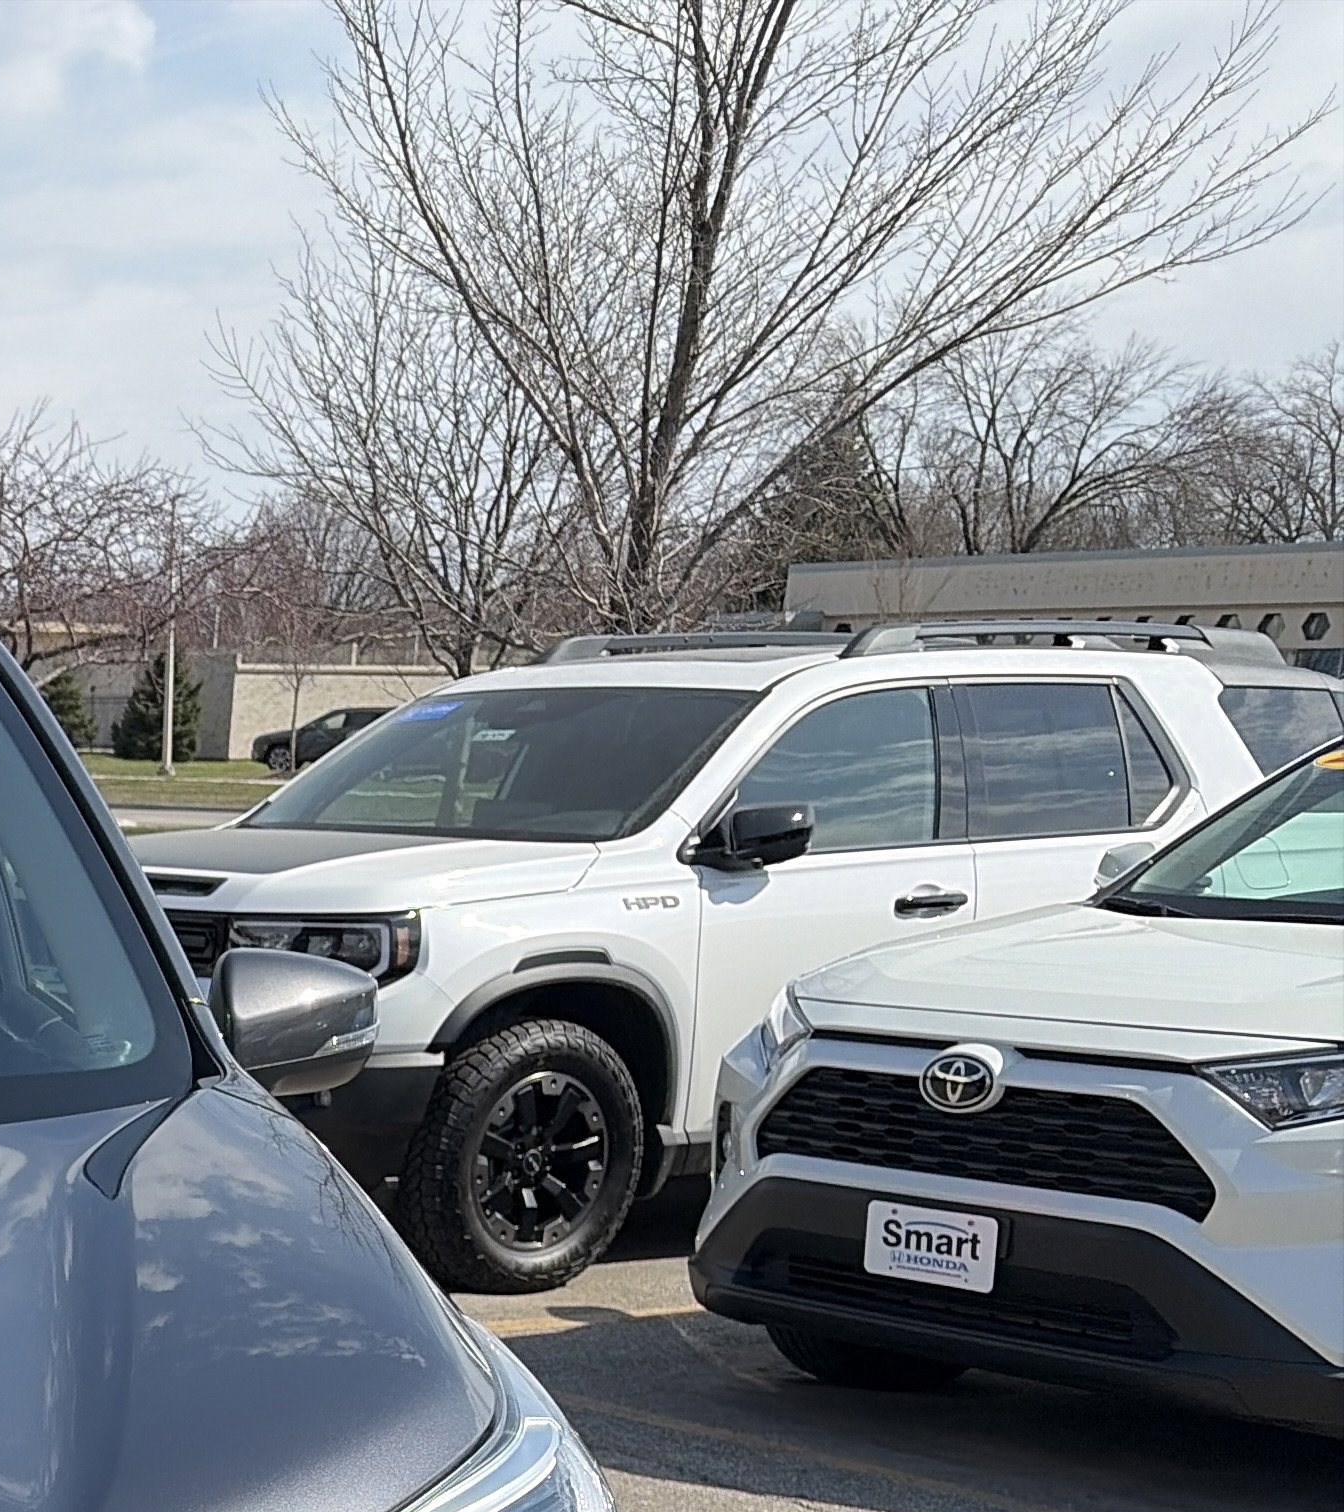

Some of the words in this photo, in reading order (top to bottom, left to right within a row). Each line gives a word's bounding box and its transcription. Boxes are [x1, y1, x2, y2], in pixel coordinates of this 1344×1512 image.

[622, 895, 680, 911] HPD
[882, 1218, 981, 1261] Smart
[906, 1254, 970, 1273] HONDA
